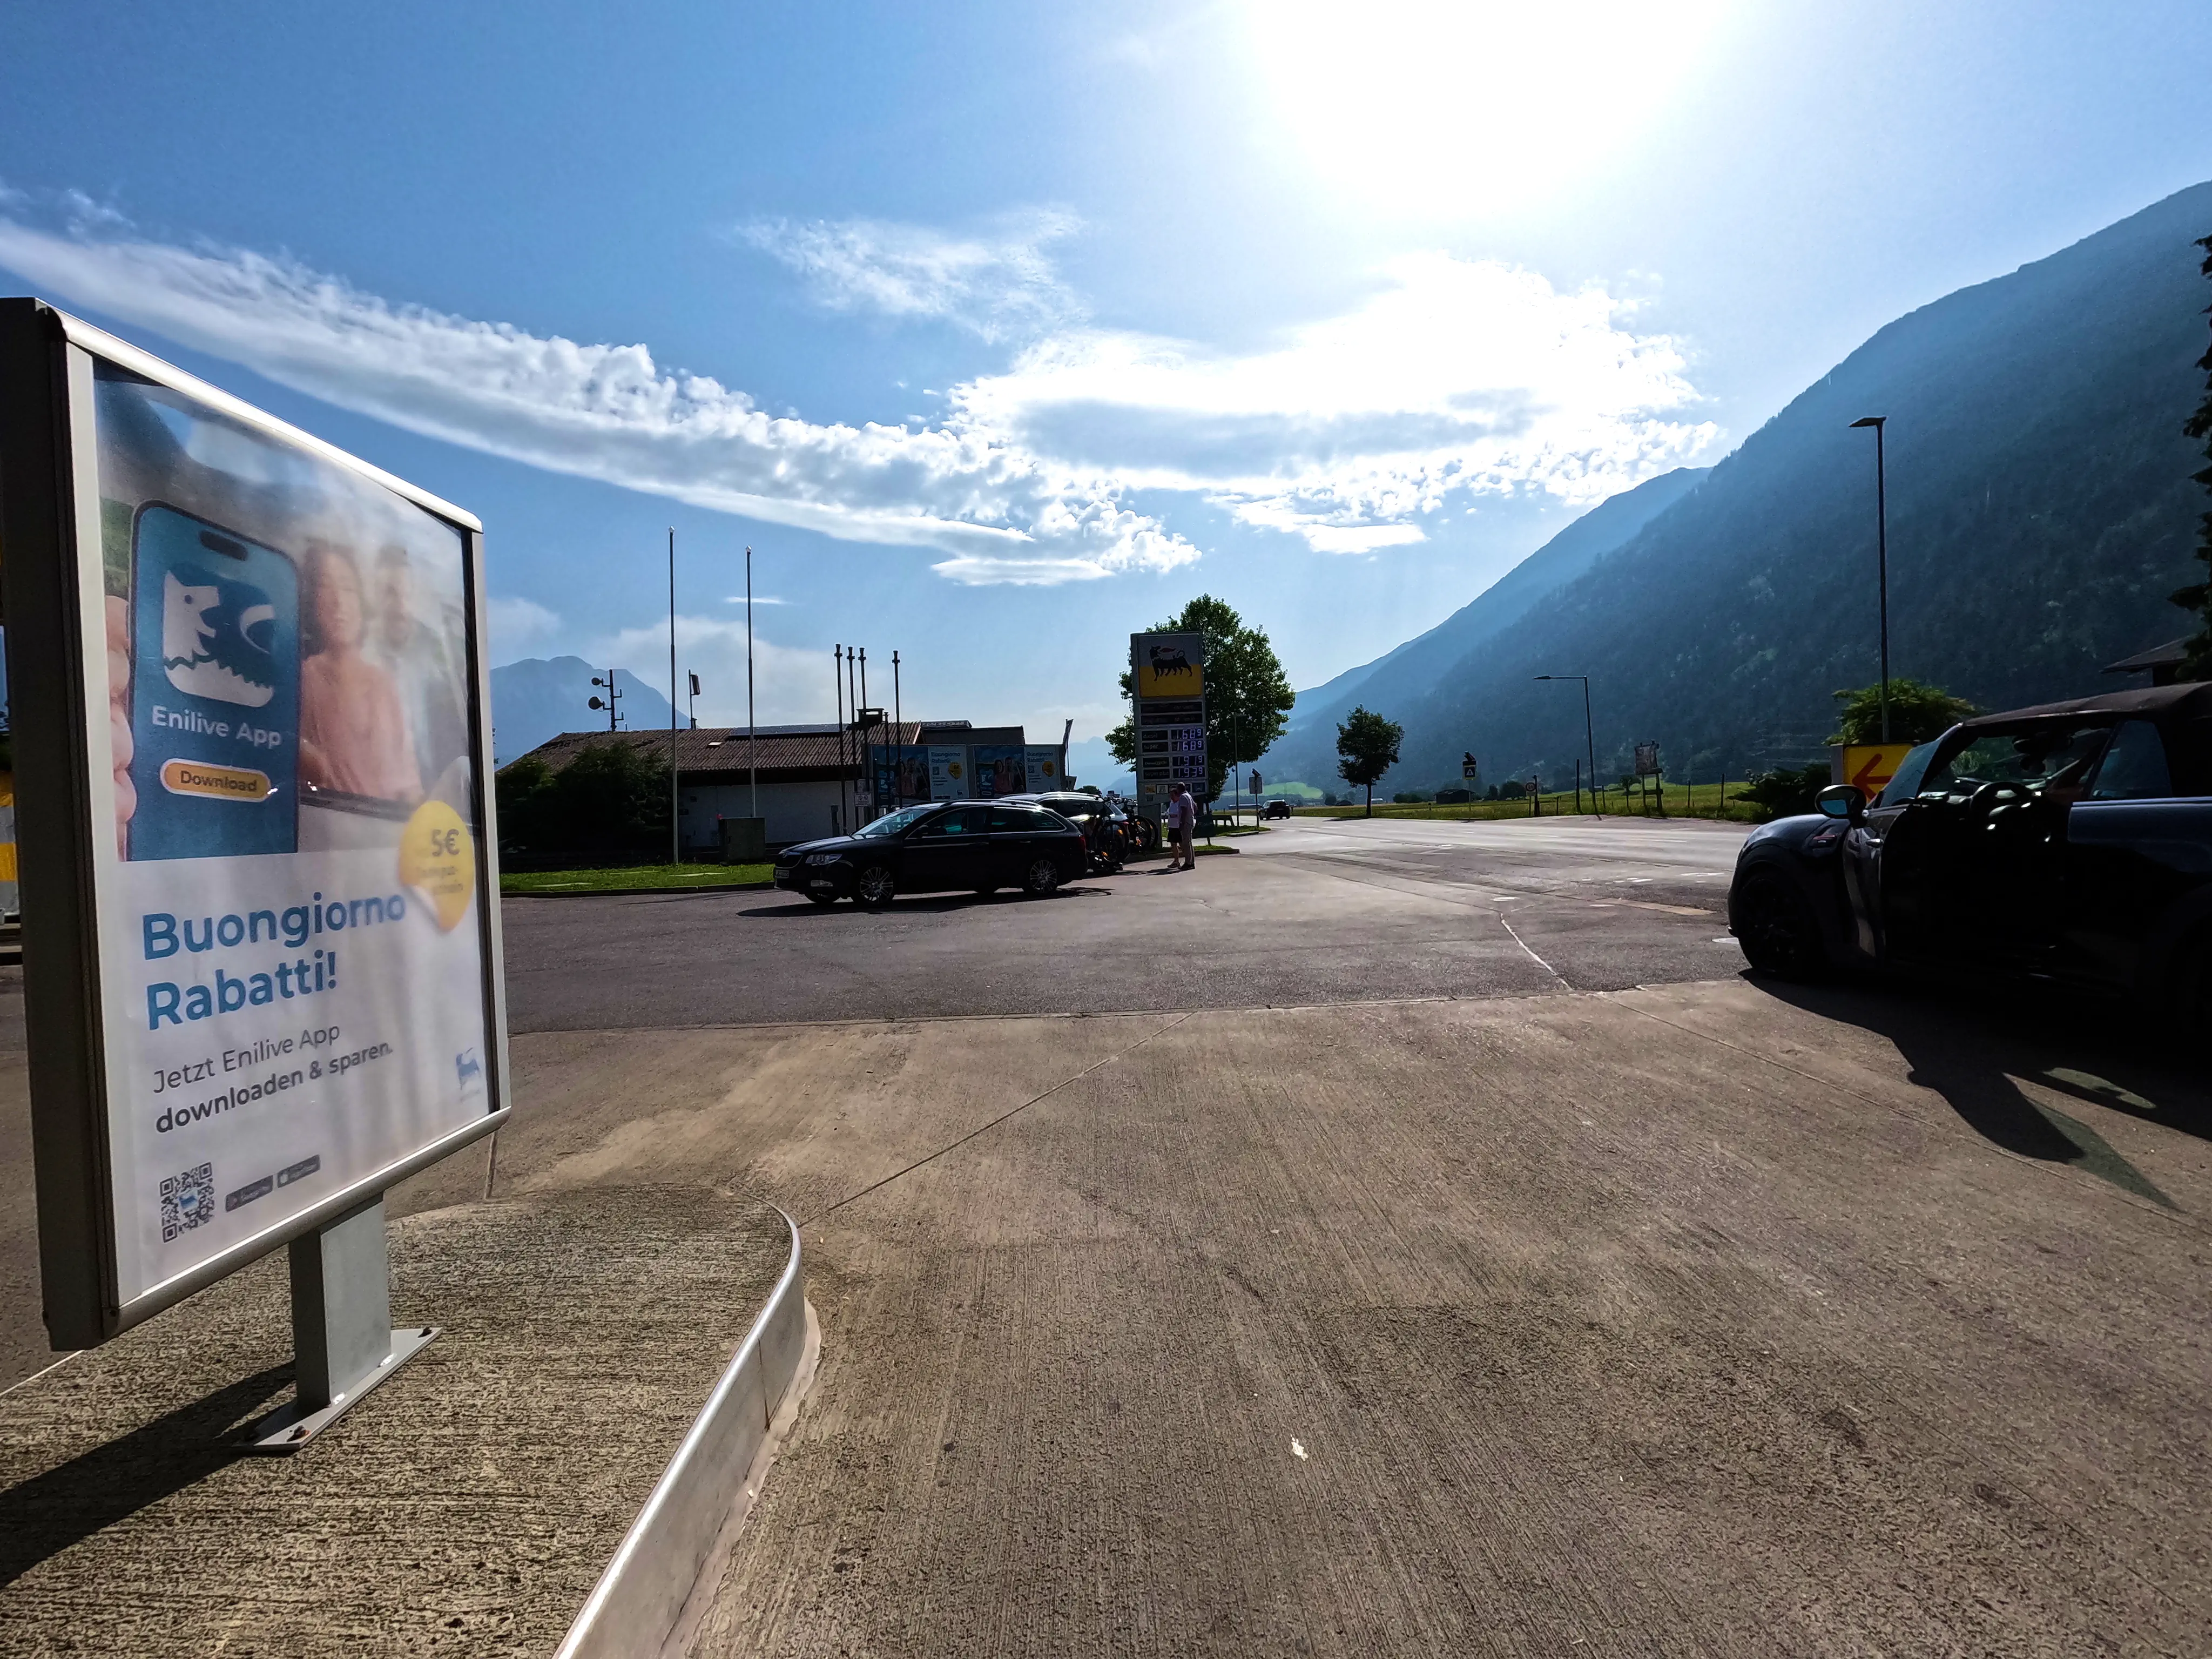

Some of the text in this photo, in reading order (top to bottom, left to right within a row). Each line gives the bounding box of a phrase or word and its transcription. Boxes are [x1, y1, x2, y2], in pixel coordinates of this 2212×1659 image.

[152, 705, 281, 749] Enilive App
[180, 770, 257, 791] Download
[431, 828, 460, 857] 5€
[143, 892, 405, 960] Buongiorno
[147, 949, 336, 1030] Rabatti!
[153, 1026, 340, 1094] Jetzt Enilive App
[156, 1041, 393, 1133] downloaden & sparen.
